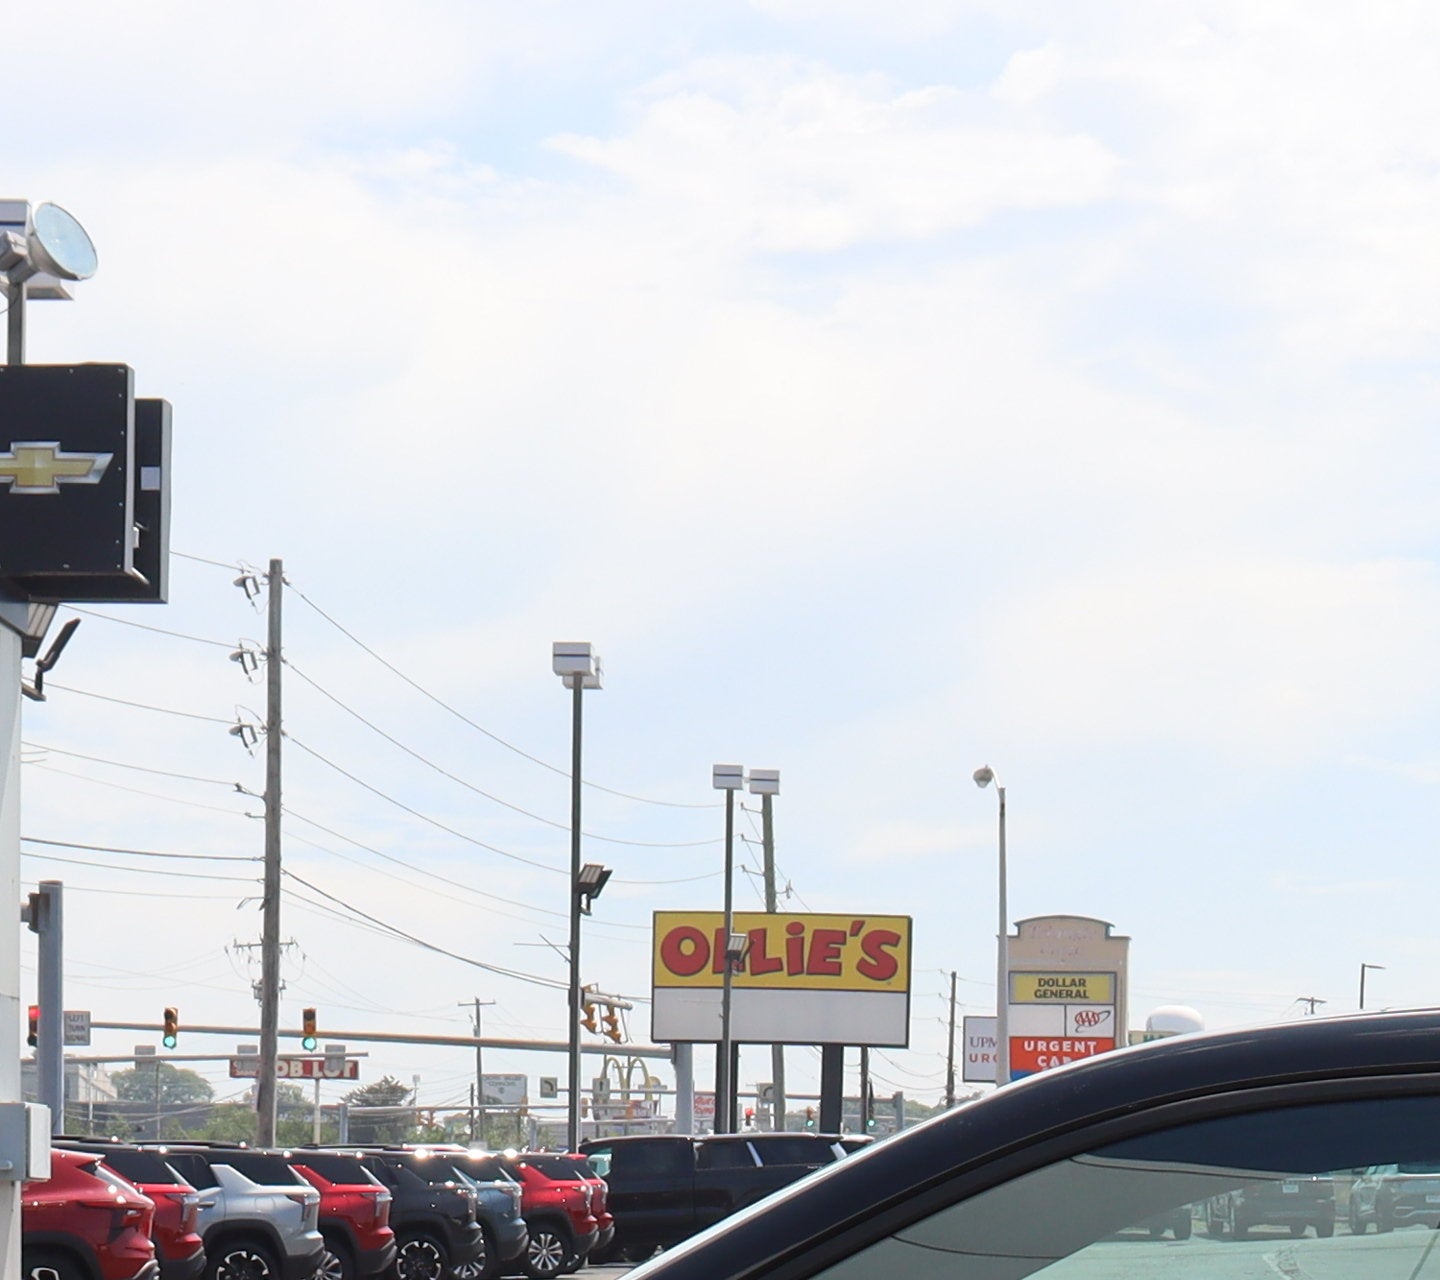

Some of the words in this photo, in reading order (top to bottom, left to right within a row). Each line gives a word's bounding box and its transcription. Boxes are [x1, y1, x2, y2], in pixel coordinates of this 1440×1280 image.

[1037, 977, 1087, 988] DOLLAR
[1034, 988, 1090, 999] GENERAL
[1023, 1040, 1097, 1055] URGENT
